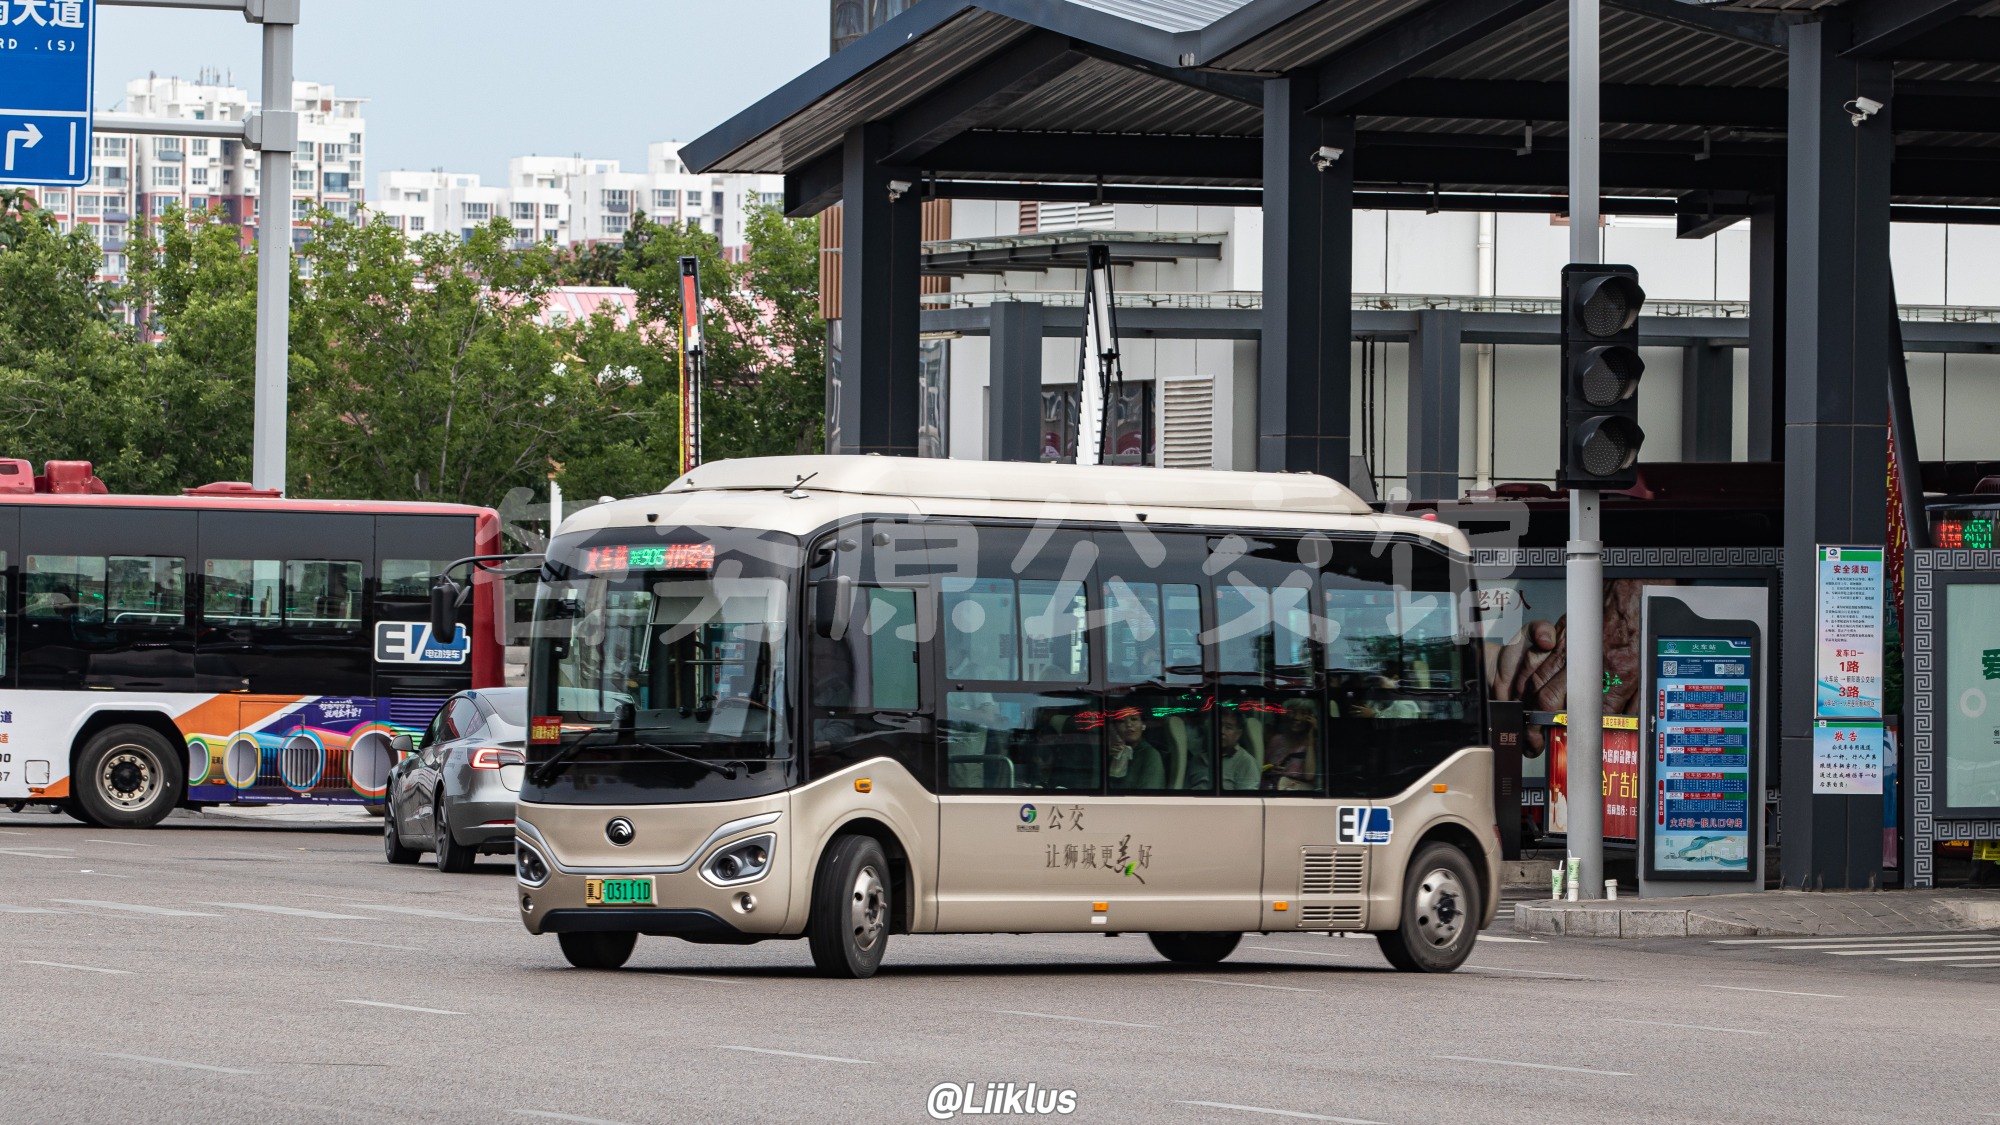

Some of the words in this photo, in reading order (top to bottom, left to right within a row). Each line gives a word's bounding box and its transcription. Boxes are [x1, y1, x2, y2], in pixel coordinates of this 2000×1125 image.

[586, 546, 629, 571] 火车站
[1833, 564, 1869, 574] 安全须知
[378, 624, 432, 660] EV
[425, 649, 460, 659] 电动汽车
[1836, 649, 1864, 657] 发车口一
[1839, 660, 1859, 673] 1路
[1839, 686, 1859, 698] 3路
[1, 711, 13, 723] 道
[1500, 733, 1517, 742] 百胜
[1834, 731, 1857, 742] 敬告
[1047, 804, 1085, 831] 公交
[1340, 807, 1371, 842] EV
[1045, 834, 1153, 885] 让狮城更美好
